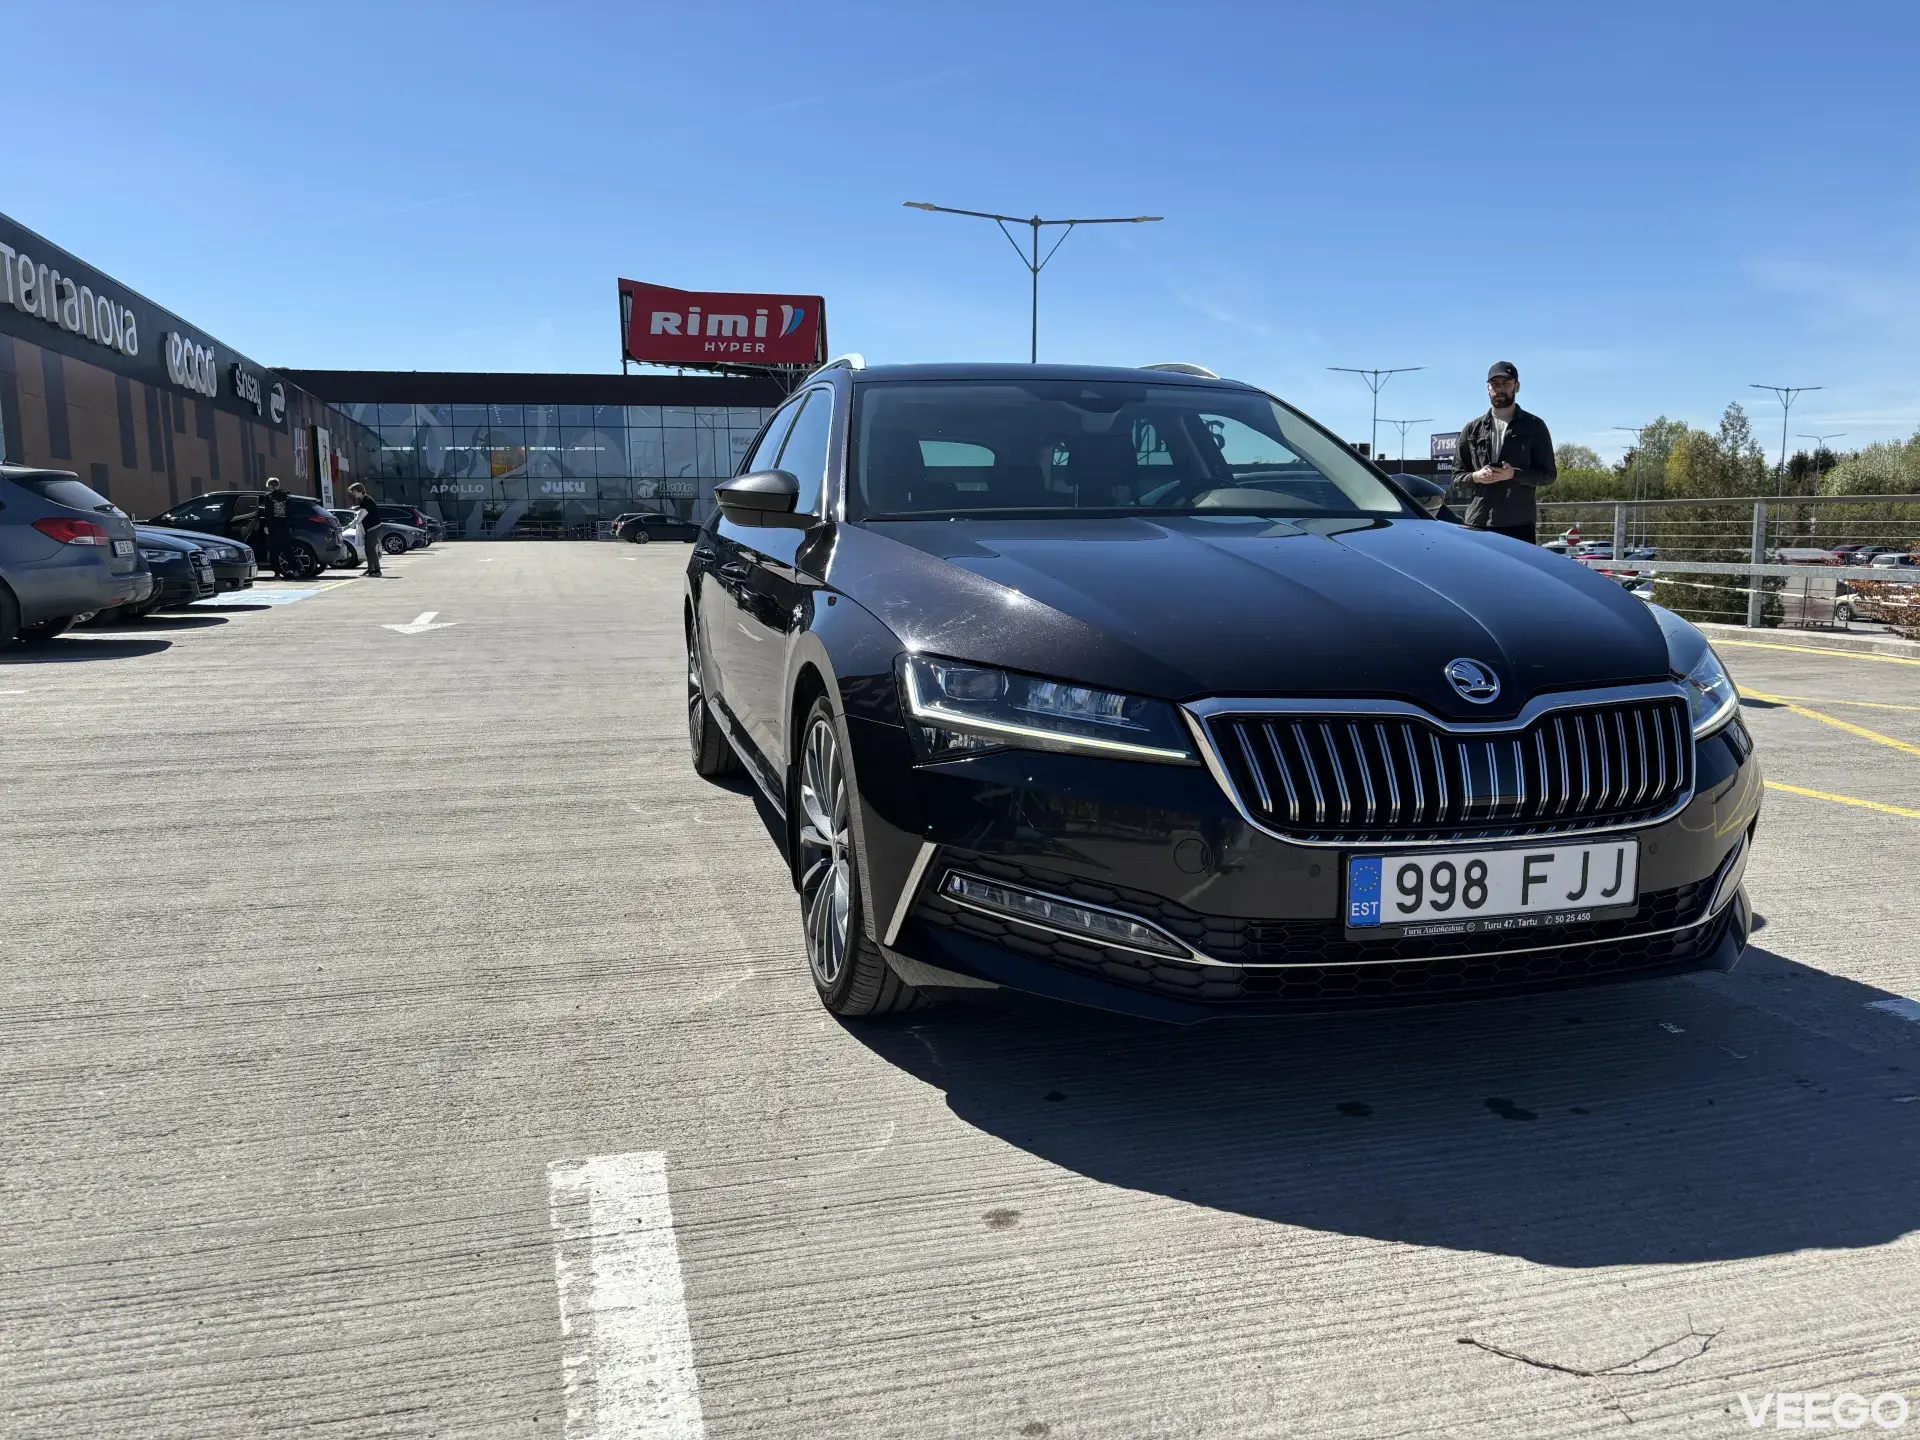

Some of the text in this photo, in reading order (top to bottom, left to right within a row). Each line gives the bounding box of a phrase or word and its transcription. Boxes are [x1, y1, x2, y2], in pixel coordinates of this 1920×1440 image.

[0, 241, 138, 356] Terranova
[650, 306, 768, 338] Rimi
[704, 341, 765, 354] HYPER
[167, 331, 217, 398] ecco
[236, 362, 262, 417] sinsay
[1436, 437, 1457, 450] JYSK
[430, 484, 485, 494] APOLLO
[541, 480, 586, 493] JUKU
[1396, 859, 1488, 914] 998
[1351, 901, 1379, 917] EST
[1403, 926, 1421, 936] Turu
[1483, 921, 1501, 930] Turu
[1503, 919, 1515, 929] 47,
[1517, 918, 1538, 927] Tartu
[1555, 915, 1564, 923] 50
[1566, 914, 1575, 922] 25
[1577, 912, 1591, 921] 450
